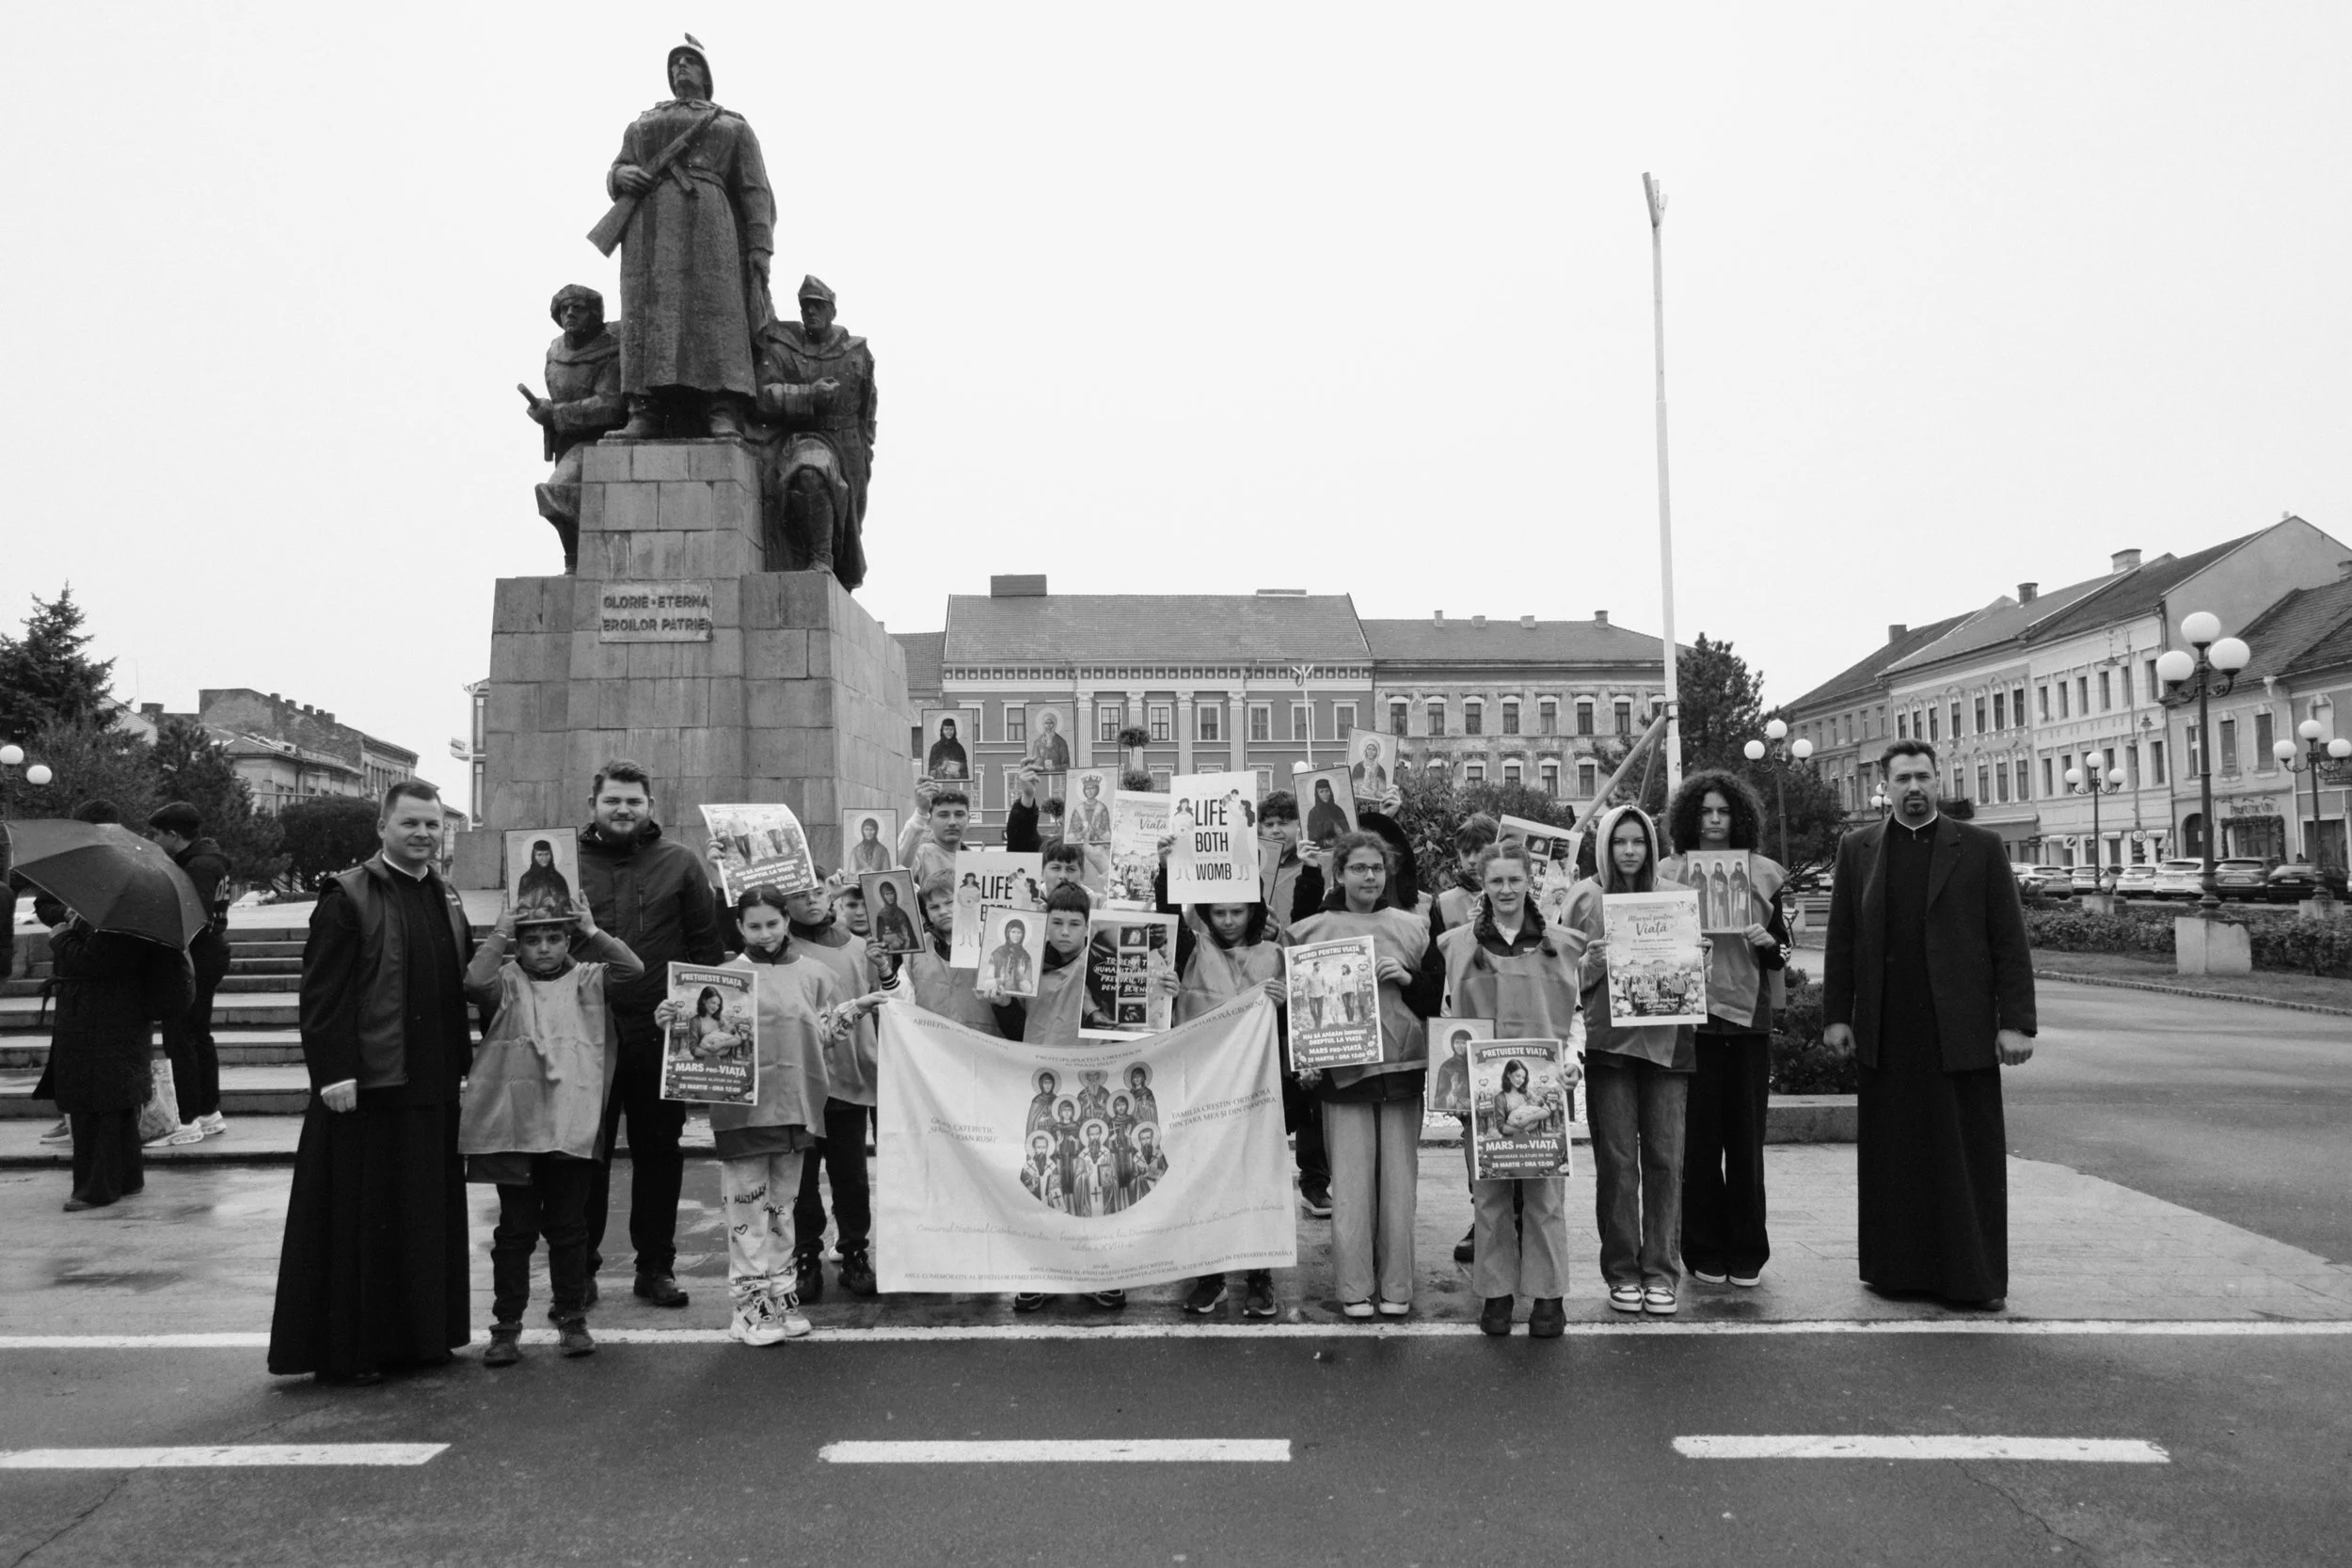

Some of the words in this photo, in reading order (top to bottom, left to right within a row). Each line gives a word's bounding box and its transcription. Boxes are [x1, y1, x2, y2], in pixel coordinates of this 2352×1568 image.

[603, 595, 649, 609] GLORIE
[658, 595, 709, 609] ETERNA
[603, 618, 658, 631] EROILOR
[1195, 800, 1228, 826] LIFE
[1195, 832, 1229, 852] BOTH
[2135, 832, 2144, 841] 30
[1196, 863, 1232, 880] WOMB
[981, 876, 1013, 899] LIFE
[1318, 946, 1342, 957] PENTRU
[1309, 1037, 1335, 1046] DREPTUL
[675, 1062, 705, 1072] MARS
[1486, 1140, 1514, 1151] MARS
